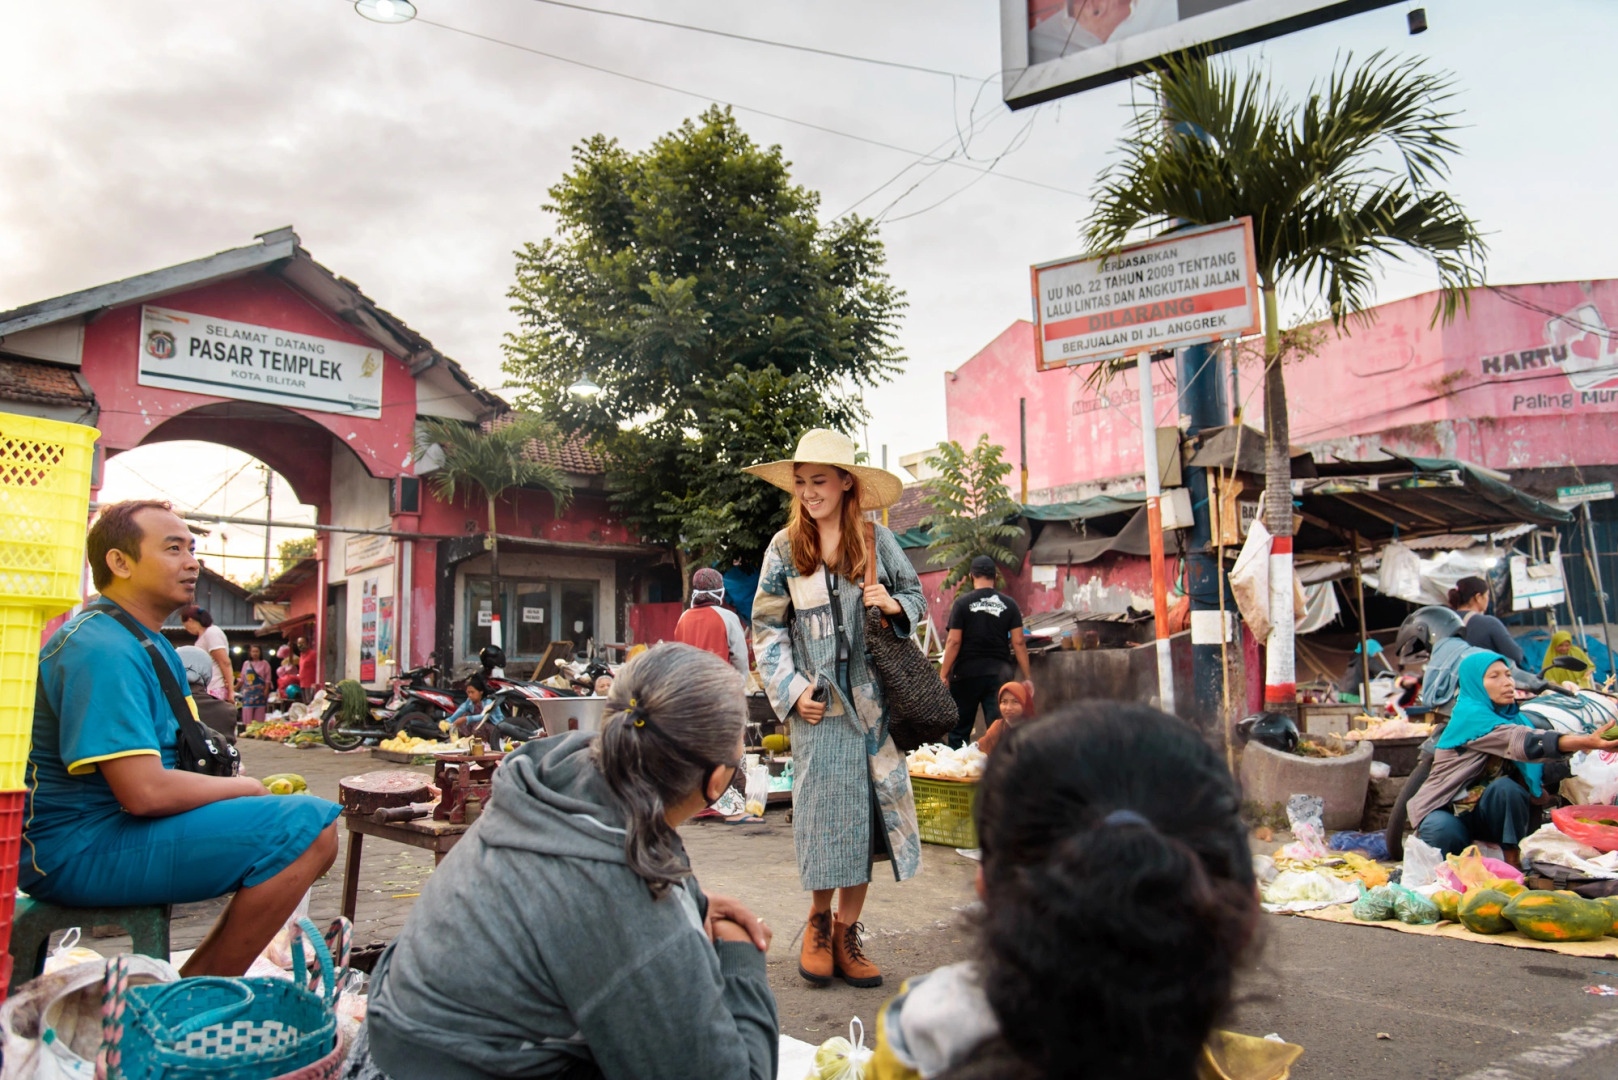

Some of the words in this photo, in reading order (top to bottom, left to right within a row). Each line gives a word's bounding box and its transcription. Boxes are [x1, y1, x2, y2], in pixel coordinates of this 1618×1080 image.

[1046, 301, 1072, 318] LALU
[1074, 295, 1111, 312] LINTAS
[1113, 289, 1135, 305] DAN
[1138, 275, 1200, 299] ANGKUTAN
[1203, 268, 1240, 287] JALAN
[1047, 287, 1063, 301] UU
[1066, 283, 1085, 298] NO.
[1088, 279, 1102, 293] 22
[1104, 270, 1144, 289] TAHUN
[1147, 264, 1175, 281] 2009
[1178, 251, 1236, 275] TENTANG
[1089, 297, 1194, 331] DILARANG
[206, 324, 268, 344] SELAMAT
[275, 336, 325, 354] DATANG
[1062, 331, 1128, 354] BERJUALAN
[1131, 329, 1143, 341] DI
[1147, 325, 1164, 338] JL.
[1167, 314, 1227, 335] ANGGREK
[189, 336, 253, 367] PASAR
[259, 349, 343, 382] TEMPLEK
[1481, 343, 1569, 374] KARTU
[231, 369, 262, 382] KOTA
[266, 374, 306, 388] BLITAR
[1512, 391, 1574, 412] Paling
